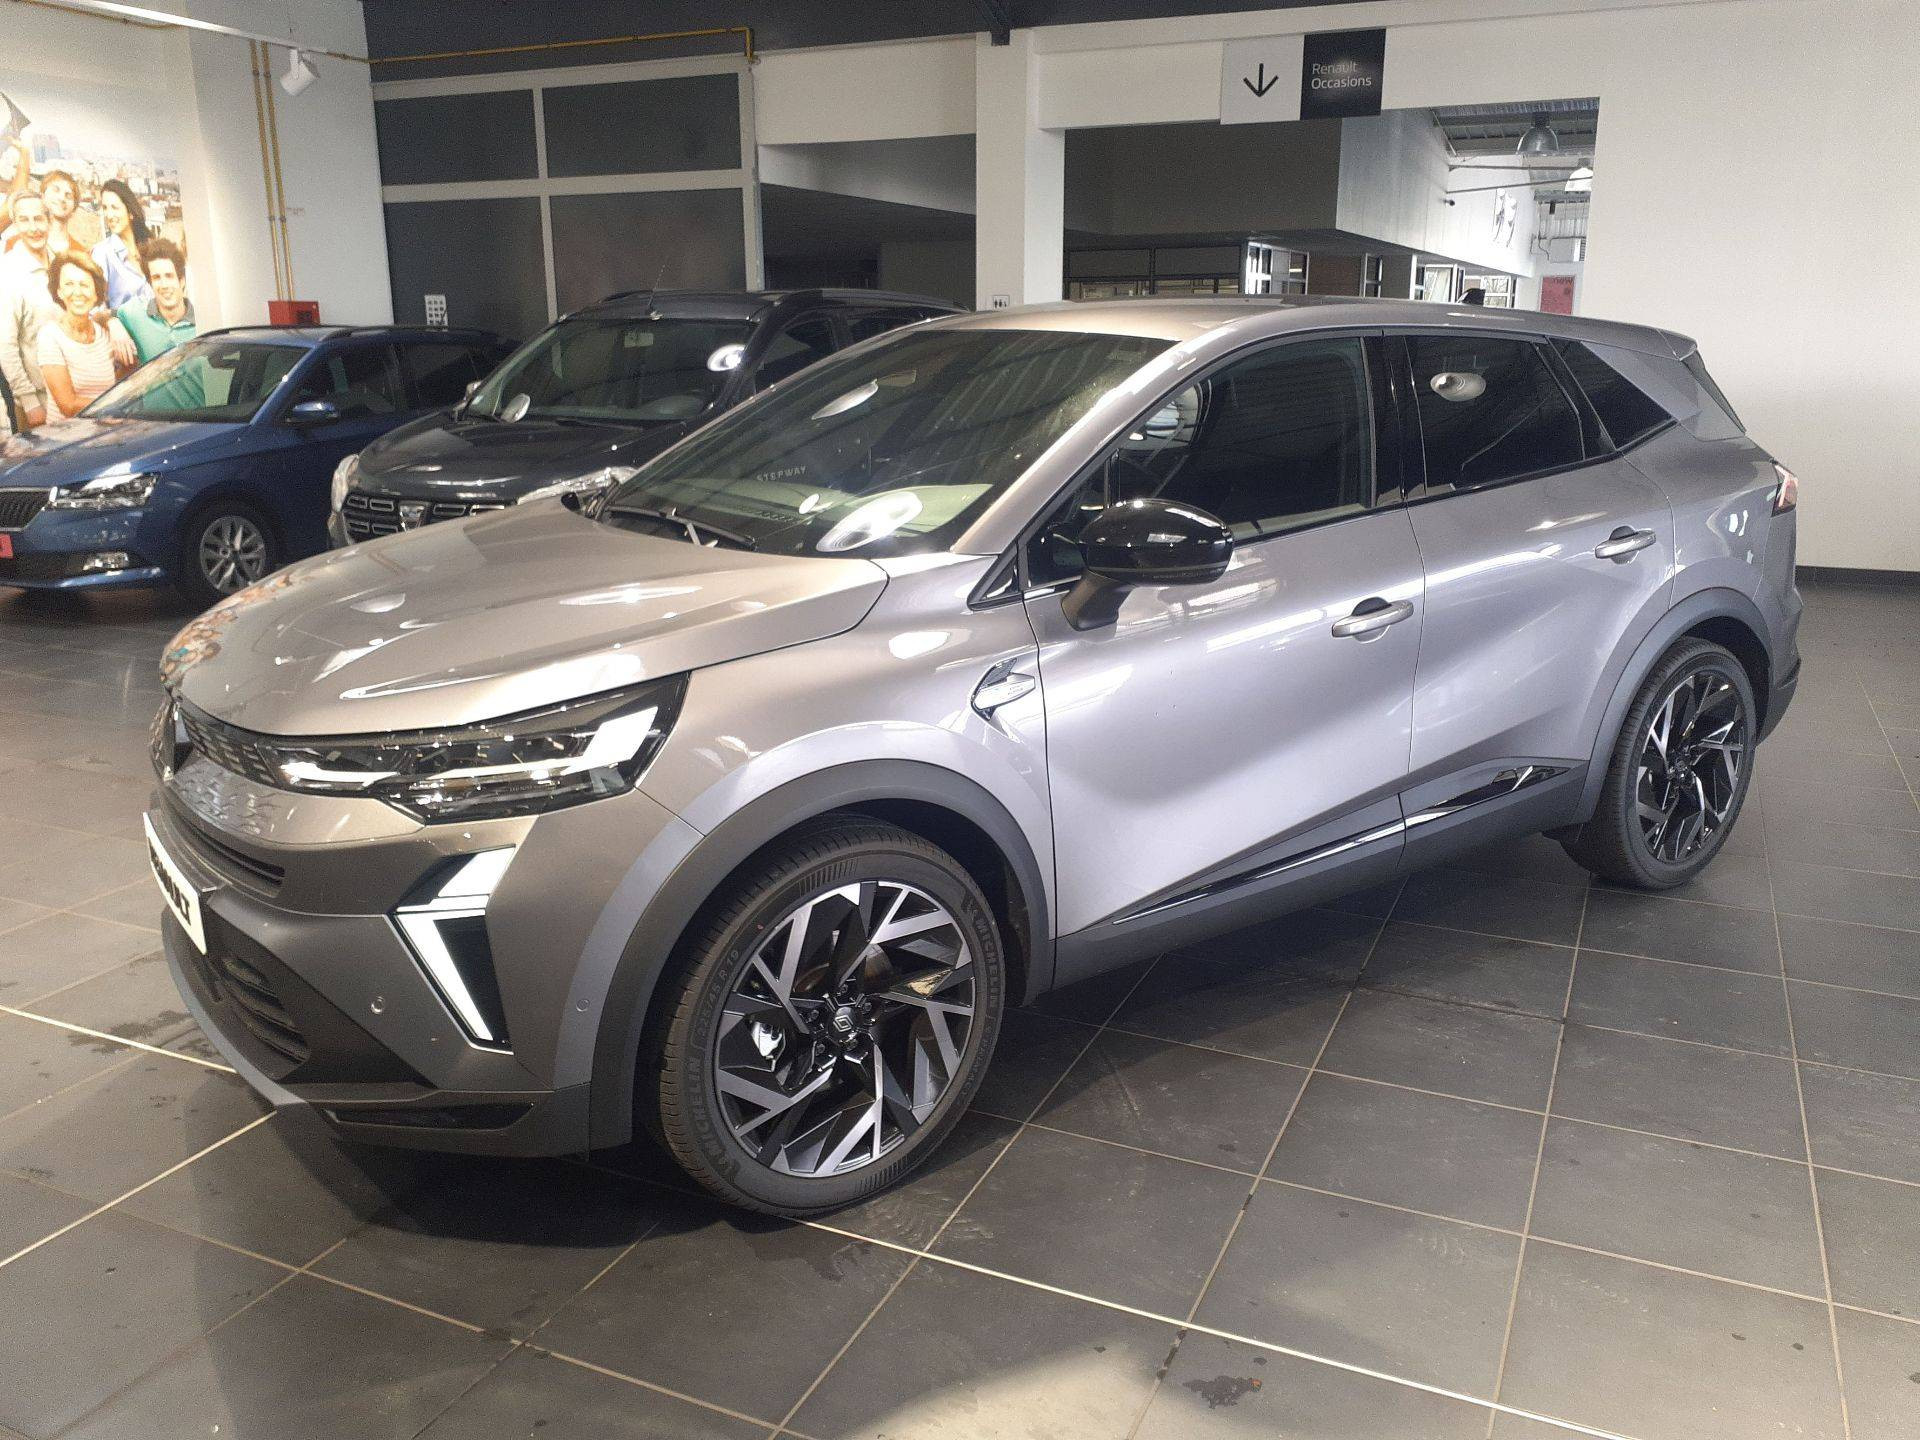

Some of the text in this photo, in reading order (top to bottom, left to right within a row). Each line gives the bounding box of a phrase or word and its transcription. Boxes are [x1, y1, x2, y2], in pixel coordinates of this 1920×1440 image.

[1312, 61, 1358, 75] Renault
[1311, 76, 1372, 89] Occasions
[756, 465, 806, 481] STEPWAY
